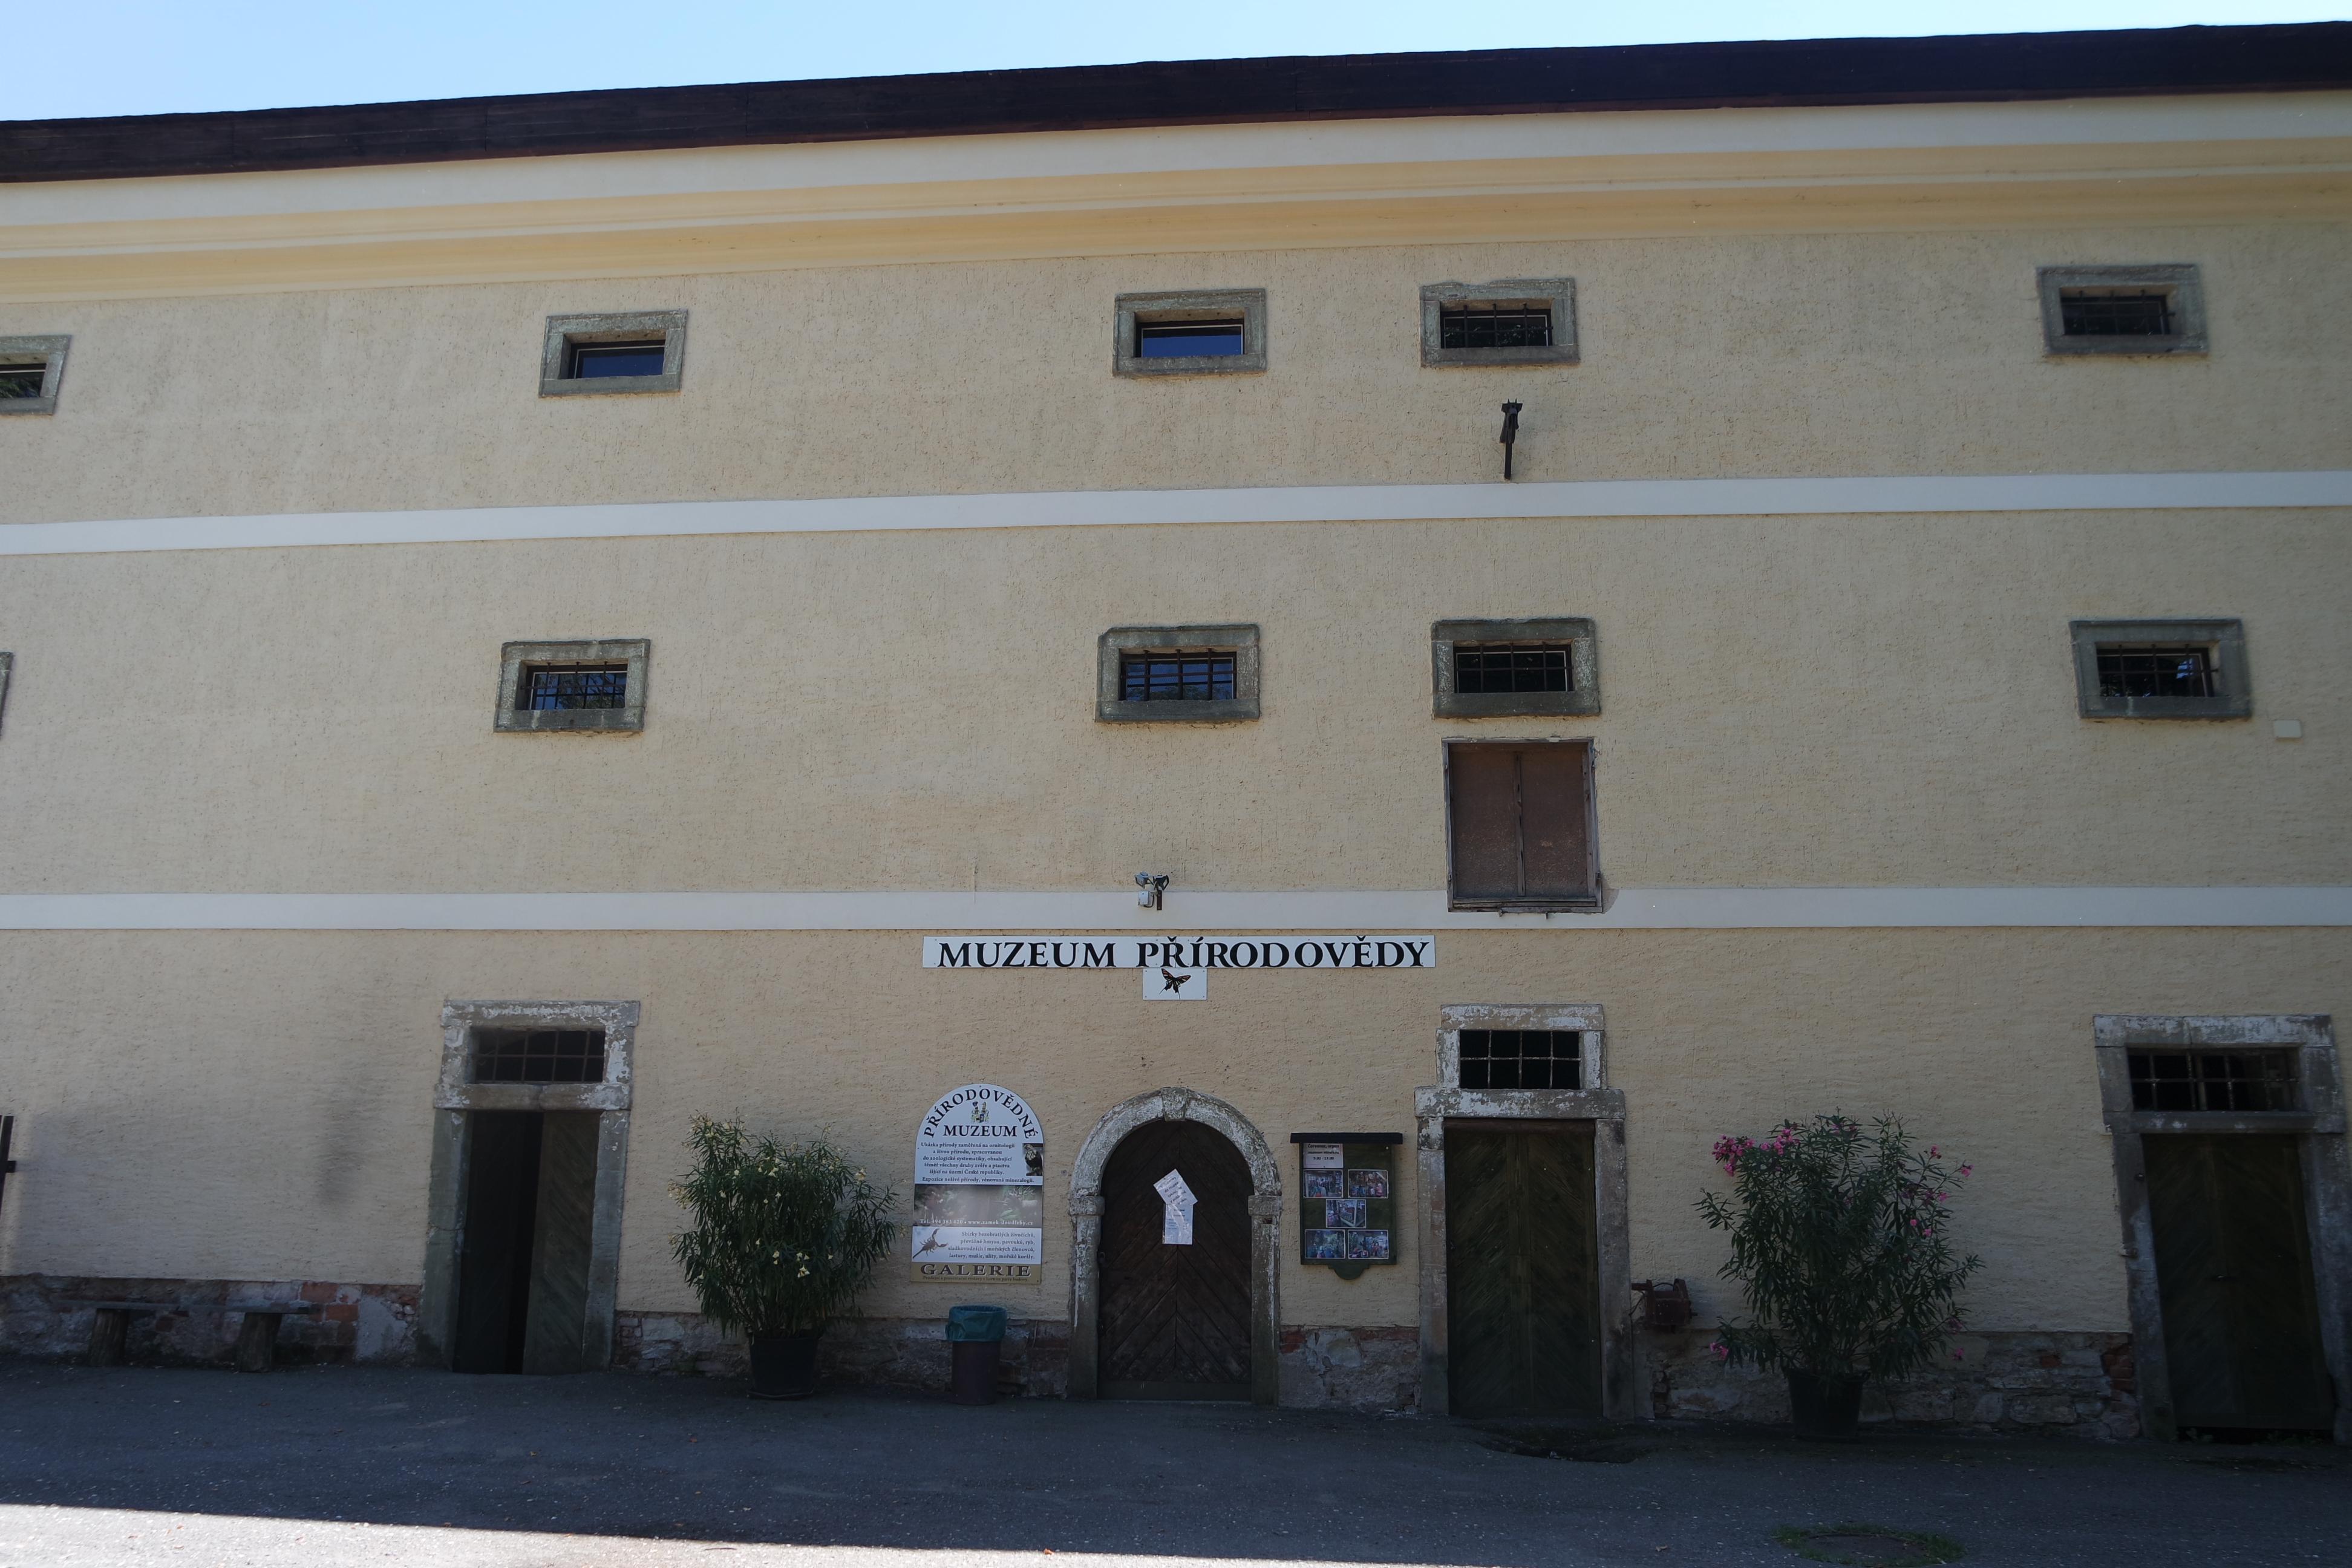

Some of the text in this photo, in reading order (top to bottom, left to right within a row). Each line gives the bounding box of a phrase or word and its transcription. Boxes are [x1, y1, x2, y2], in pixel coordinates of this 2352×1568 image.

[937, 936, 1430, 968] MUZEUM PŘÍRODOVĚDY
[924, 1088, 1038, 1138] PŘÍRODOVĚDNÉ
[942, 1125, 1018, 1137] MUZEUM
[921, 1264, 1031, 1277] GALERIE
